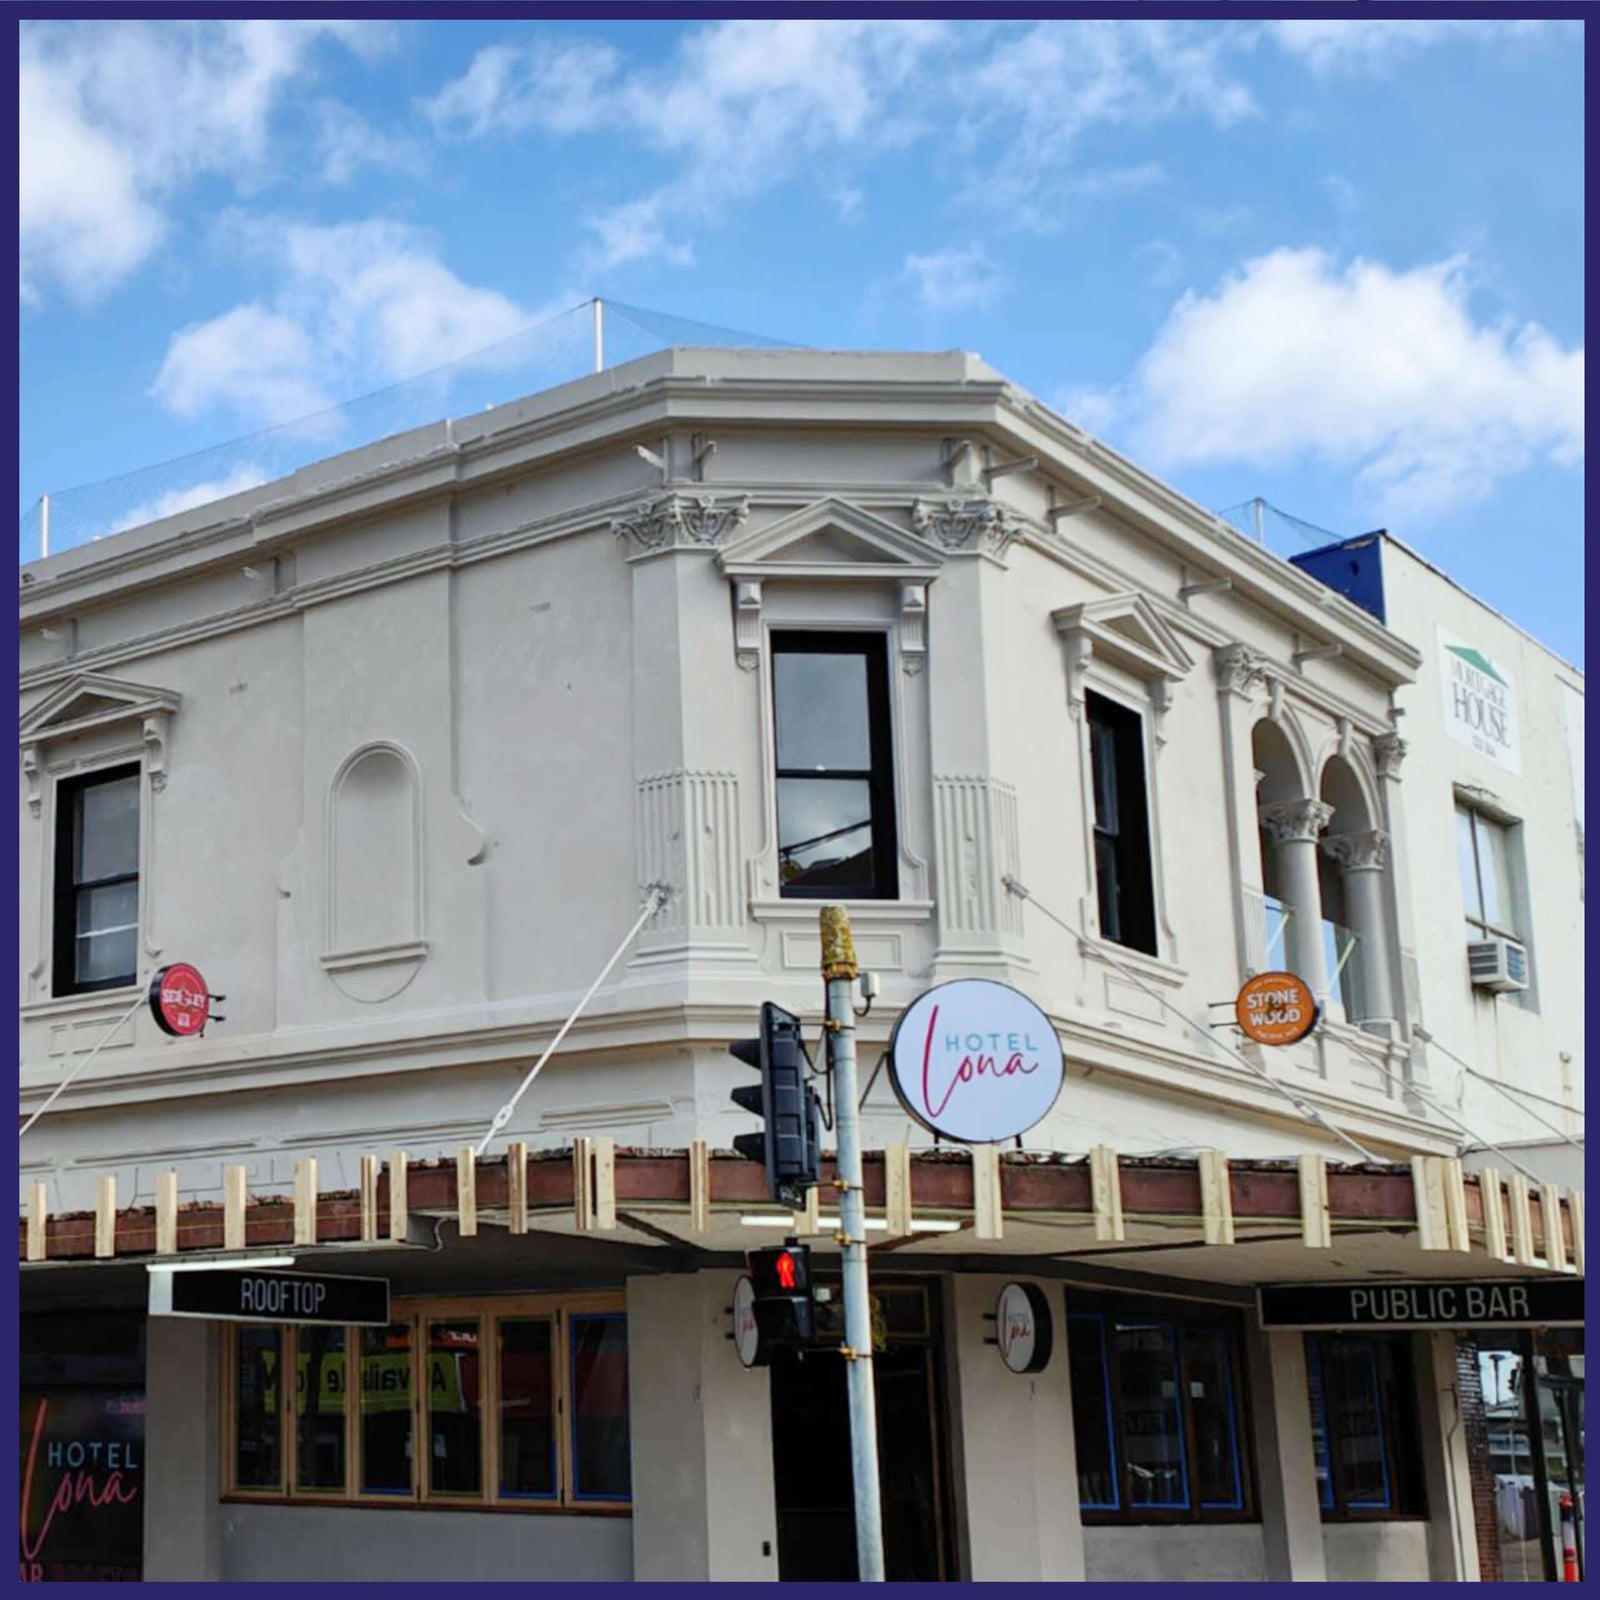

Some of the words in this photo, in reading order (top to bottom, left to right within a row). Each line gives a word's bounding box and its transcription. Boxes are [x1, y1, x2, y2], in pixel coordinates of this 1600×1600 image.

[1453, 681, 1511, 749] HOUSE
[1246, 988, 1300, 1009] STONE
[1250, 1007, 1301, 1027] WOOD
[945, 1033, 1038, 1052] HOTEL
[240, 1278, 327, 1314] ROOFTOP
[1350, 1287, 1458, 1321] PUBLIC
[1465, 1286, 1531, 1318] BAR
[47, 1440, 139, 1470] HOTEL
